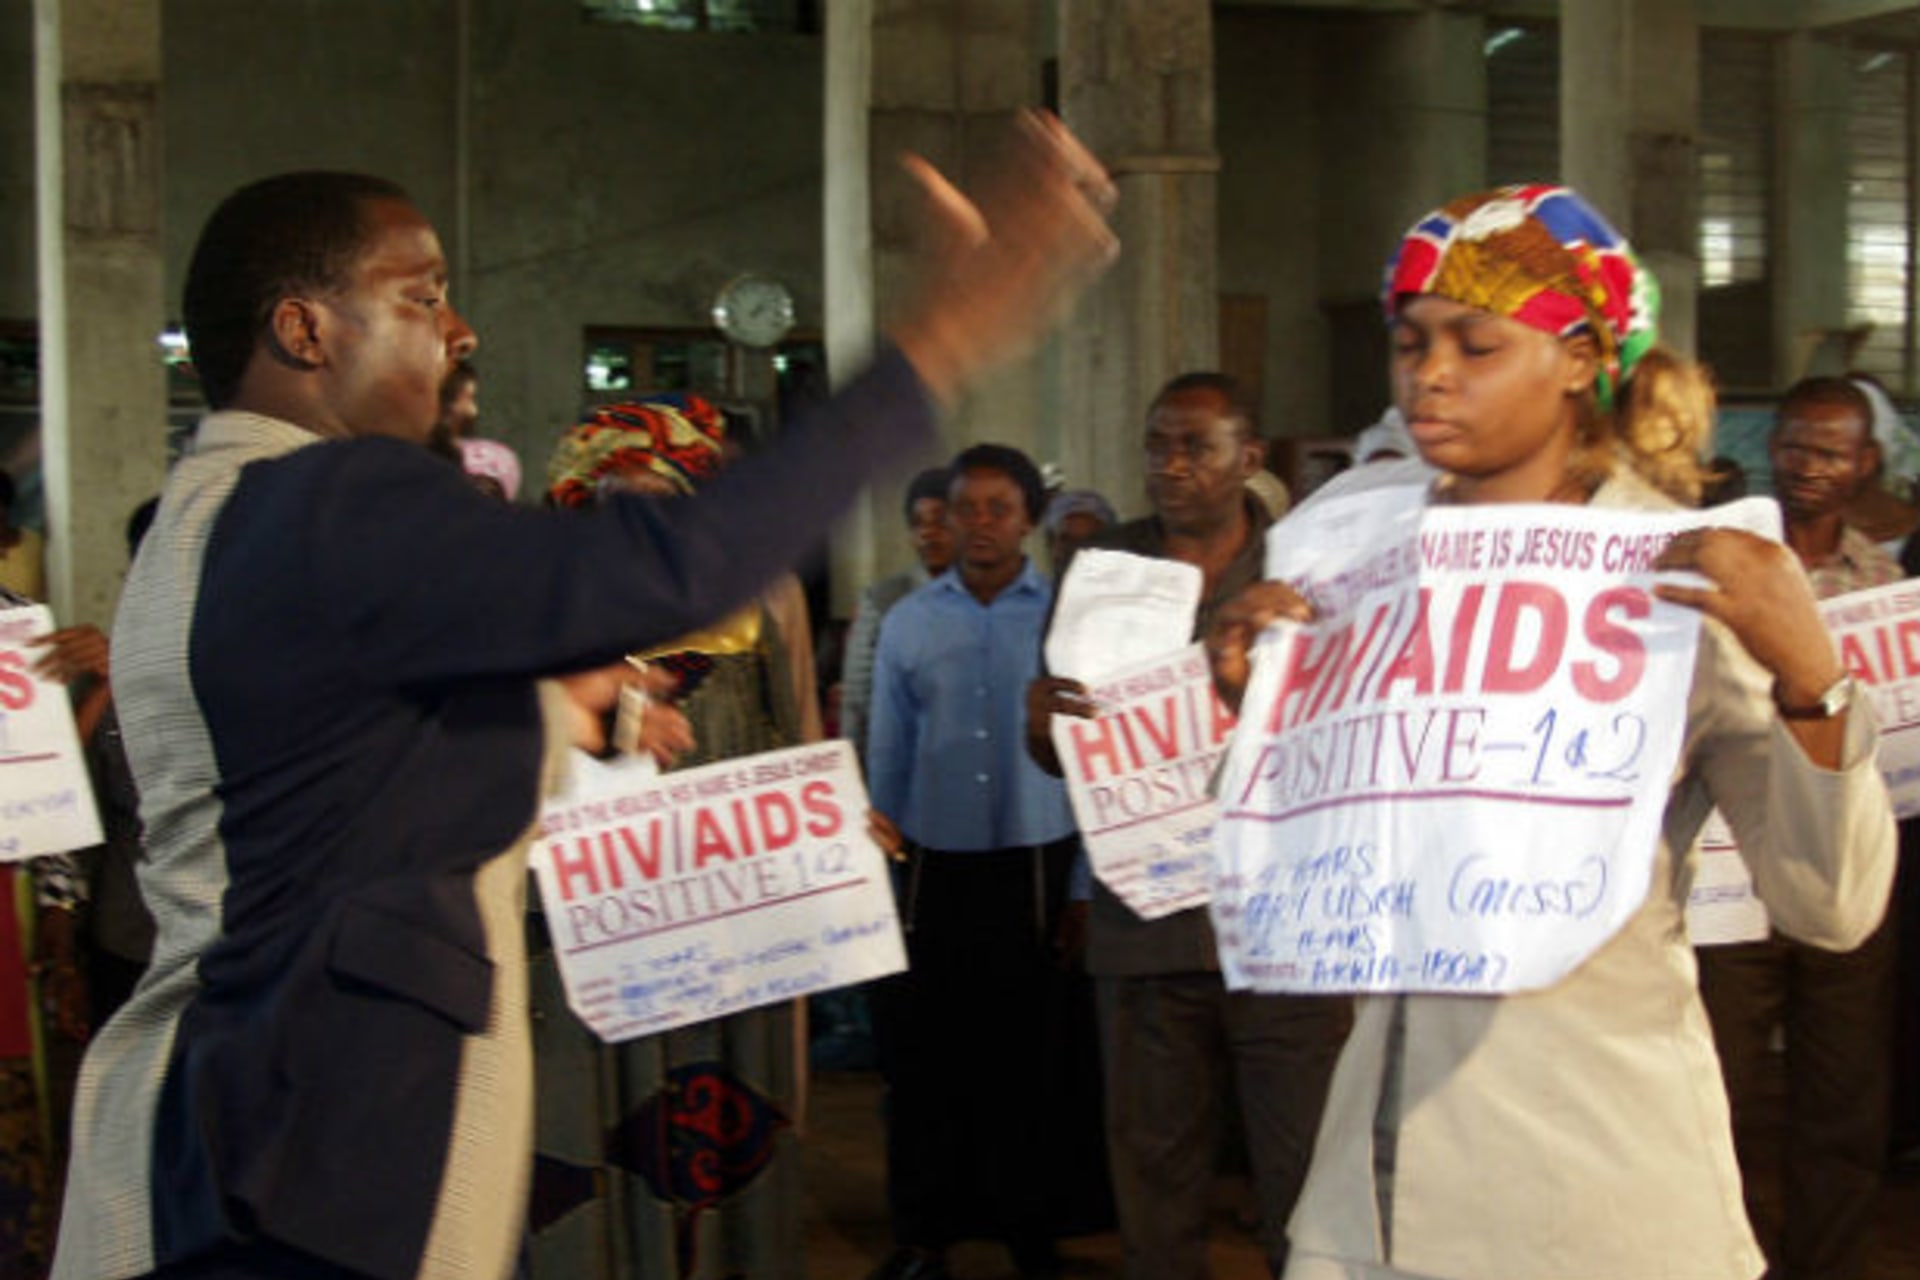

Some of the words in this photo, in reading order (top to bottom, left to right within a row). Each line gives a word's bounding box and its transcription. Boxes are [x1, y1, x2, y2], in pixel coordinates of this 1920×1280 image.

[1420, 530, 1485, 570] NAME
[1490, 530, 1514, 569] IS
[1515, 527, 1598, 571] JESUS
[1266, 582, 1652, 736] HIV/AIDS
[550, 781, 844, 901] HIV/AIDS
[568, 857, 786, 945] POSITIVE
